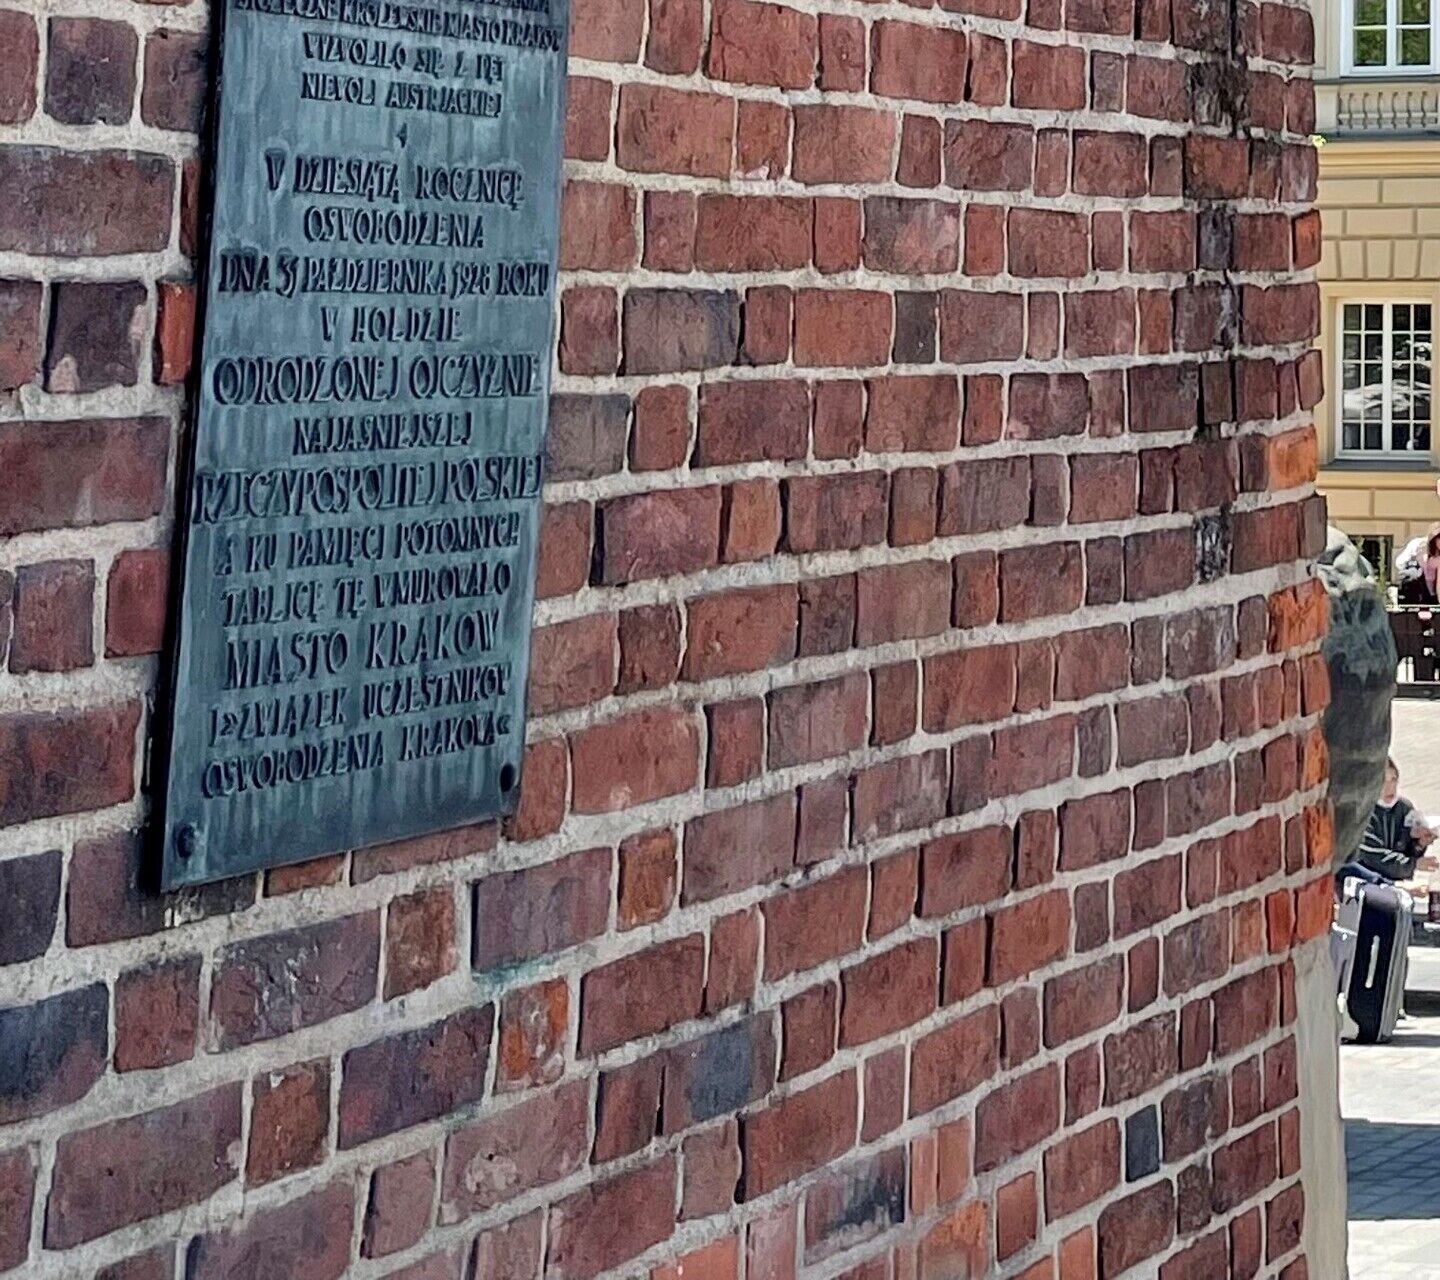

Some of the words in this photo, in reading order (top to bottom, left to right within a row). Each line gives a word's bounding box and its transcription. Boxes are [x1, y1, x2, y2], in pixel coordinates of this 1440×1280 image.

[443, 11, 501, 44] MIASTO
[454, 50, 468, 78] Z
[263, 146, 287, 192] W
[415, 164, 525, 212] ROCZNICĘ
[303, 204, 485, 249] OSWOBODZENIA
[449, 260, 491, 301] 1928
[496, 261, 550, 297] ROKU
[320, 306, 340, 342] W
[212, 354, 400, 406] ODRODZONEJ
[192, 462, 436, 525] RZECZYPOSPOLITEJ
[440, 453, 543, 505] POLSKIEJ
[244, 533, 279, 574] KU
[393, 511, 521, 561] POTOMNYCH
[222, 630, 349, 691] MIASTO
[201, 729, 385, 800] OSWOBODZENIA
